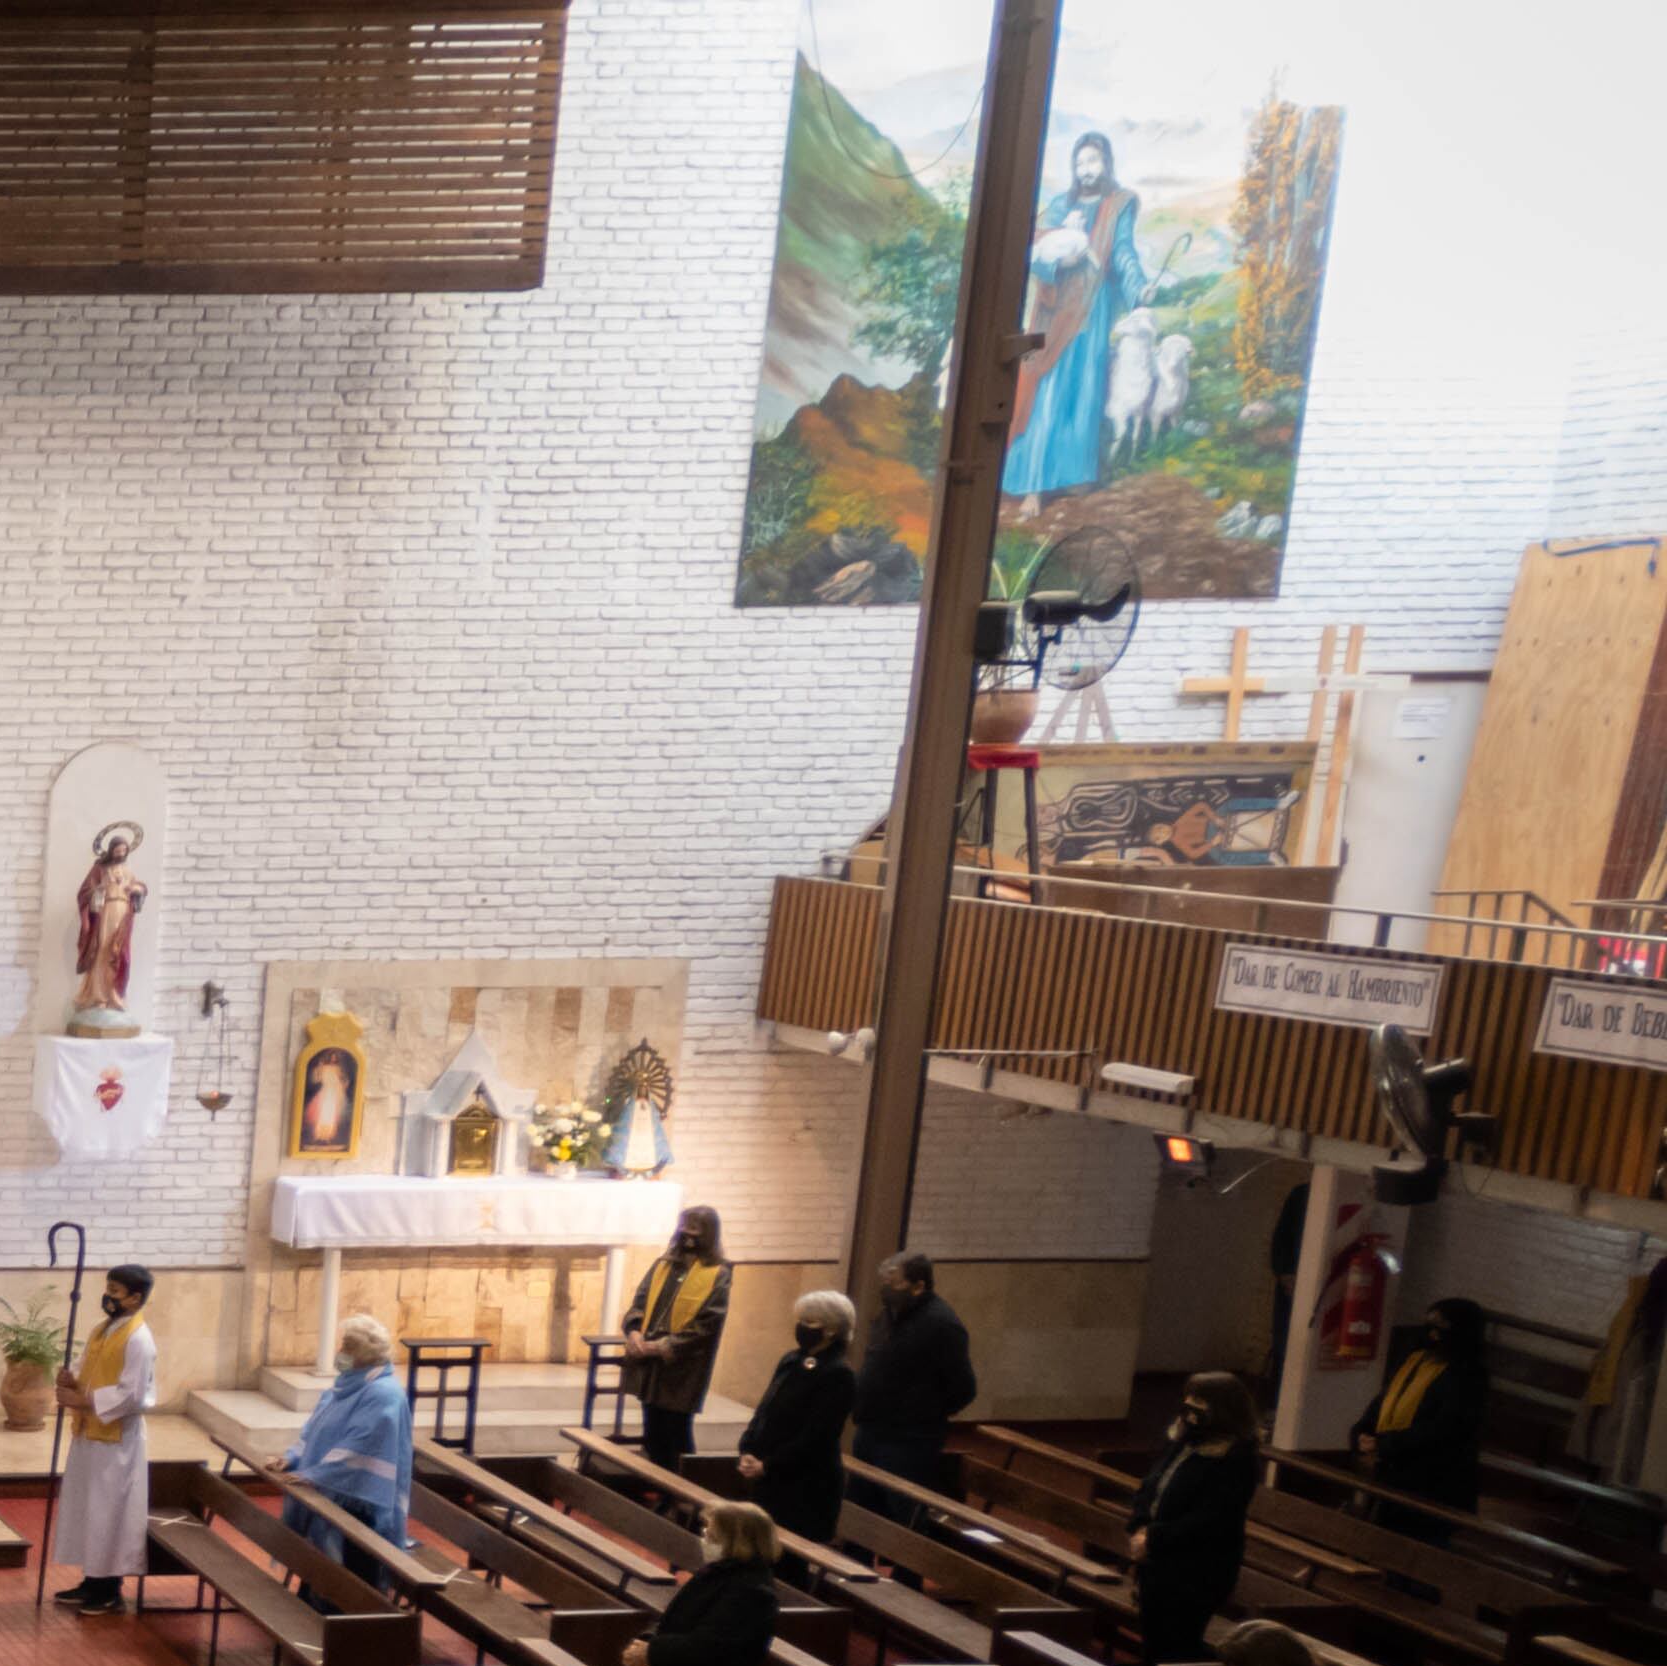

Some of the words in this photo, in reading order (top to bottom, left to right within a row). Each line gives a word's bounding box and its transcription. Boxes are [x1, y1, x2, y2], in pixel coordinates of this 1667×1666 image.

[1263, 965, 1277, 989] DE
[1284, 961, 1323, 995] COMER
[1326, 973, 1342, 998] AL
[1602, 1005, 1625, 1033] DE
